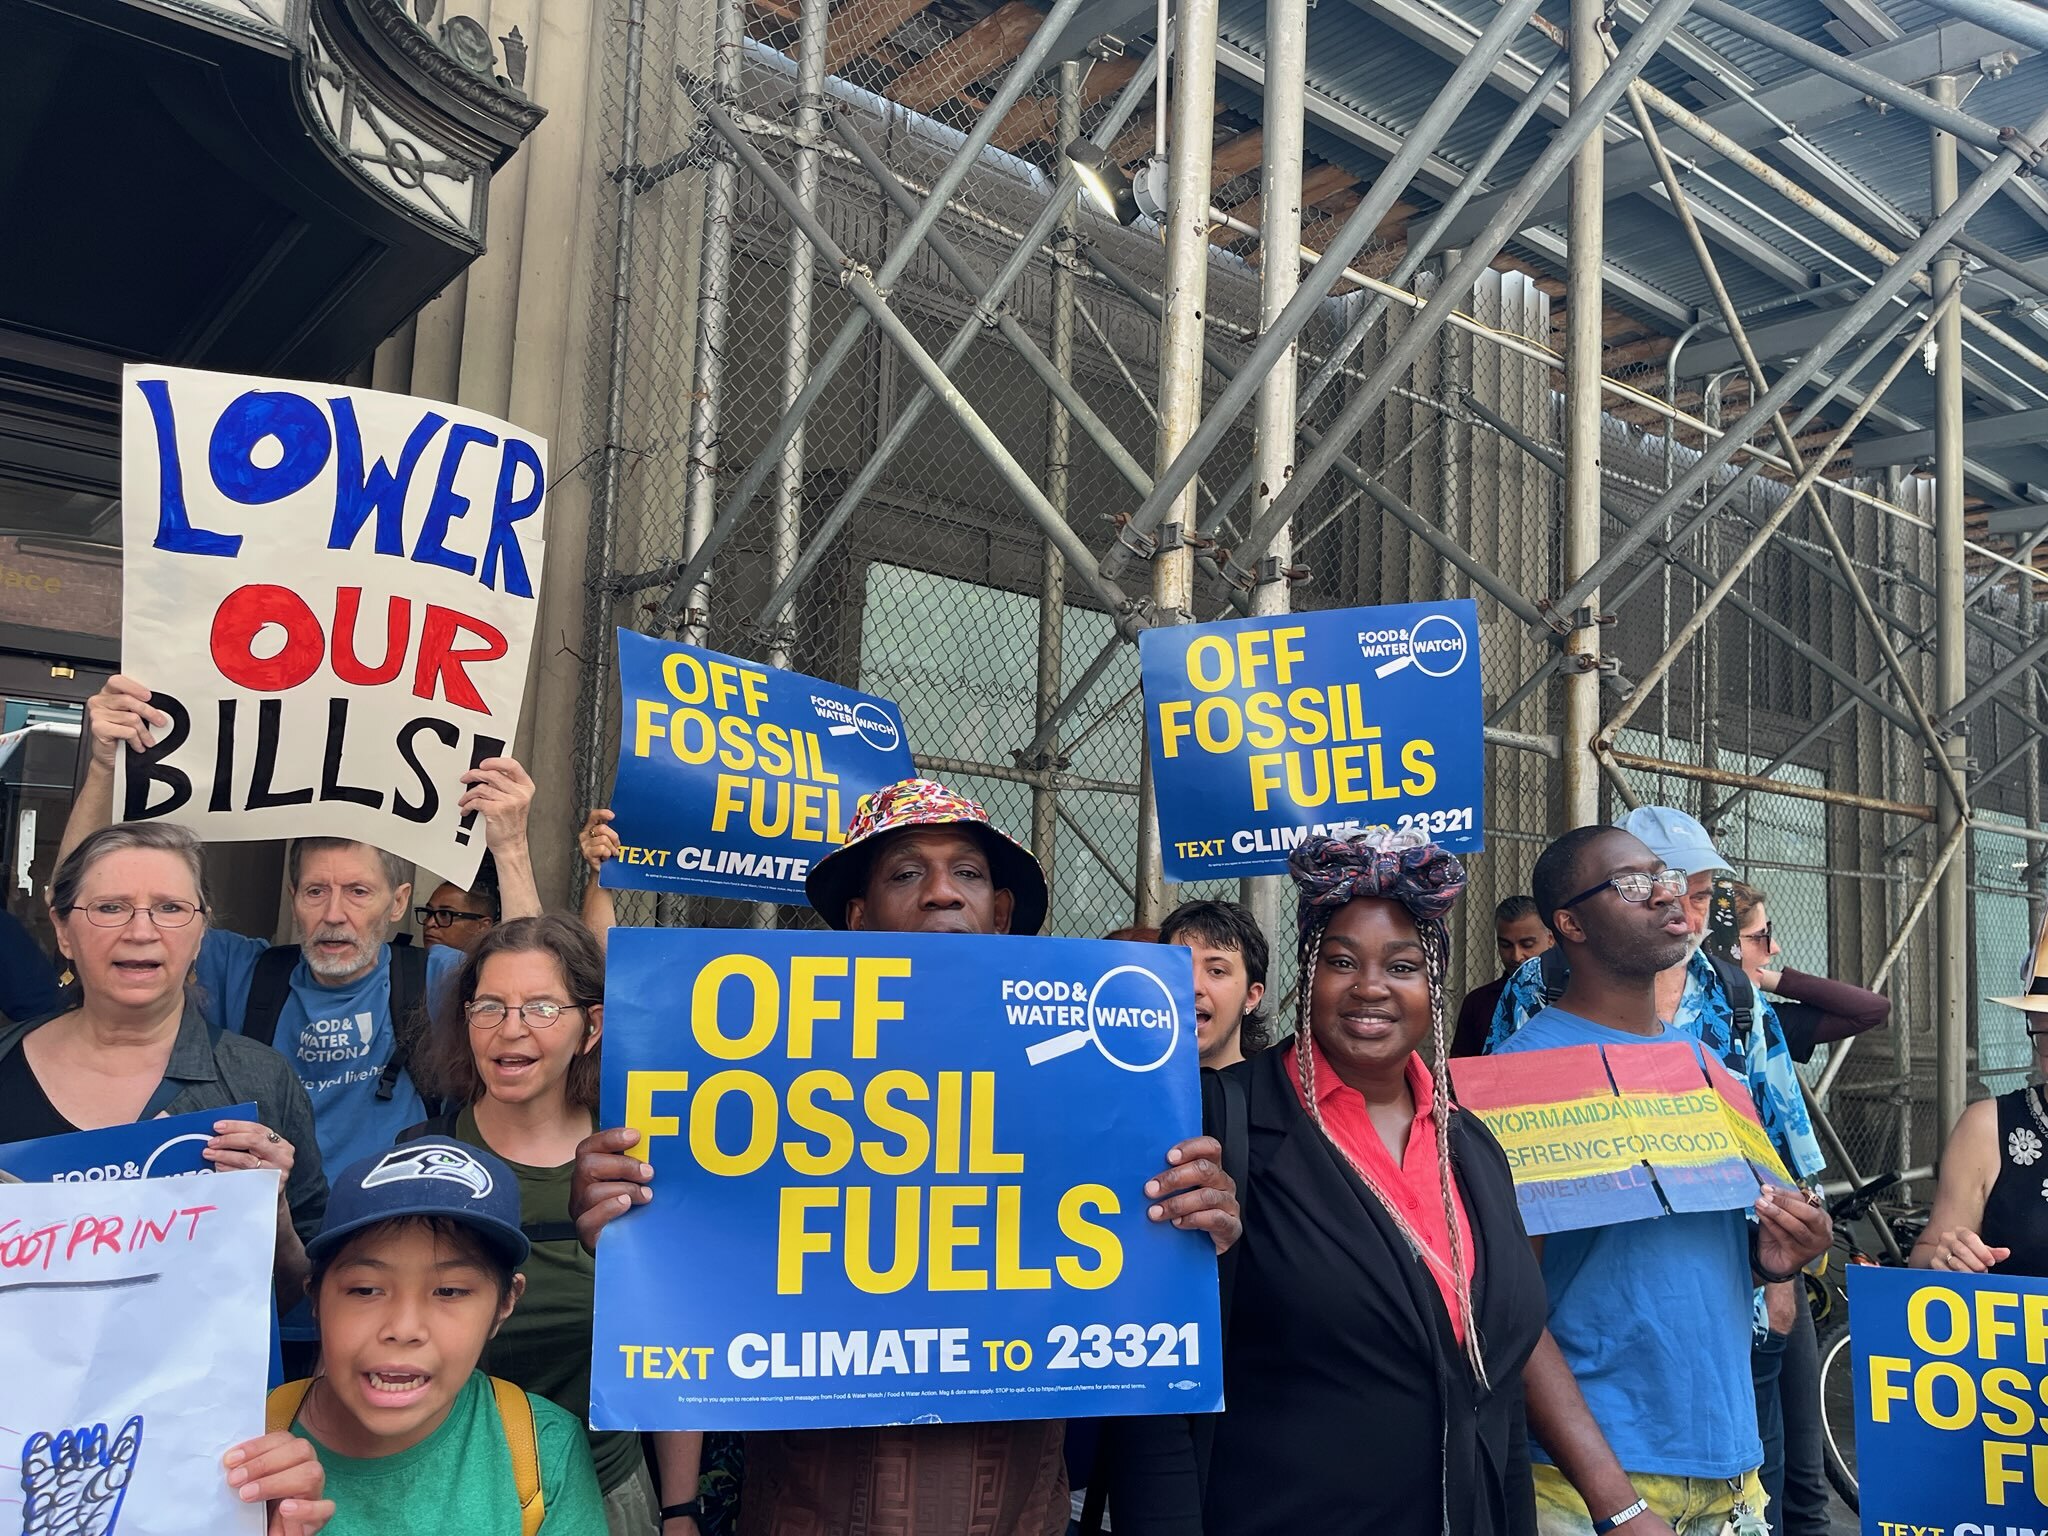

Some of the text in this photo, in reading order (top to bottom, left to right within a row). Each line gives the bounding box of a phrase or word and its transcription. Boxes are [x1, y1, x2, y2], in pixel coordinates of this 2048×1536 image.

[136, 380, 545, 599] LOWER
[0, 566, 62, 594] ace
[210, 583, 509, 716] OUR
[1186, 626, 1306, 693] OFF
[1361, 638, 1462, 658] WATER WATCH
[661, 653, 769, 717] OFF
[815, 706, 853, 724] WATER
[634, 699, 839, 785] FOSSIL
[857, 717, 895, 736] WATCH
[1159, 683, 1381, 759] FOSSIL
[123, 691, 506, 846] BILLS!
[1249, 739, 1437, 812] FUELS
[711, 774, 871, 844] FUEL
[1175, 807, 1473, 859] TEXT CLIM 23321
[618, 846, 809, 882] TEXT CLIMATE
[691, 954, 911, 1060] OFF
[1006, 1003, 1171, 1030] WATER WATCH
[296, 1046, 358, 1062] ACTION
[300, 1032, 350, 1048] WATER
[624, 1069, 1024, 1177] FOSSIL
[1518, 1180, 1590, 1206] OWER
[777, 1183, 1124, 1295] FUELS
[620, 1322, 1200, 1379] TEXT CLIMATE TO 23321
[1869, 1355, 2048, 1437] FOS
